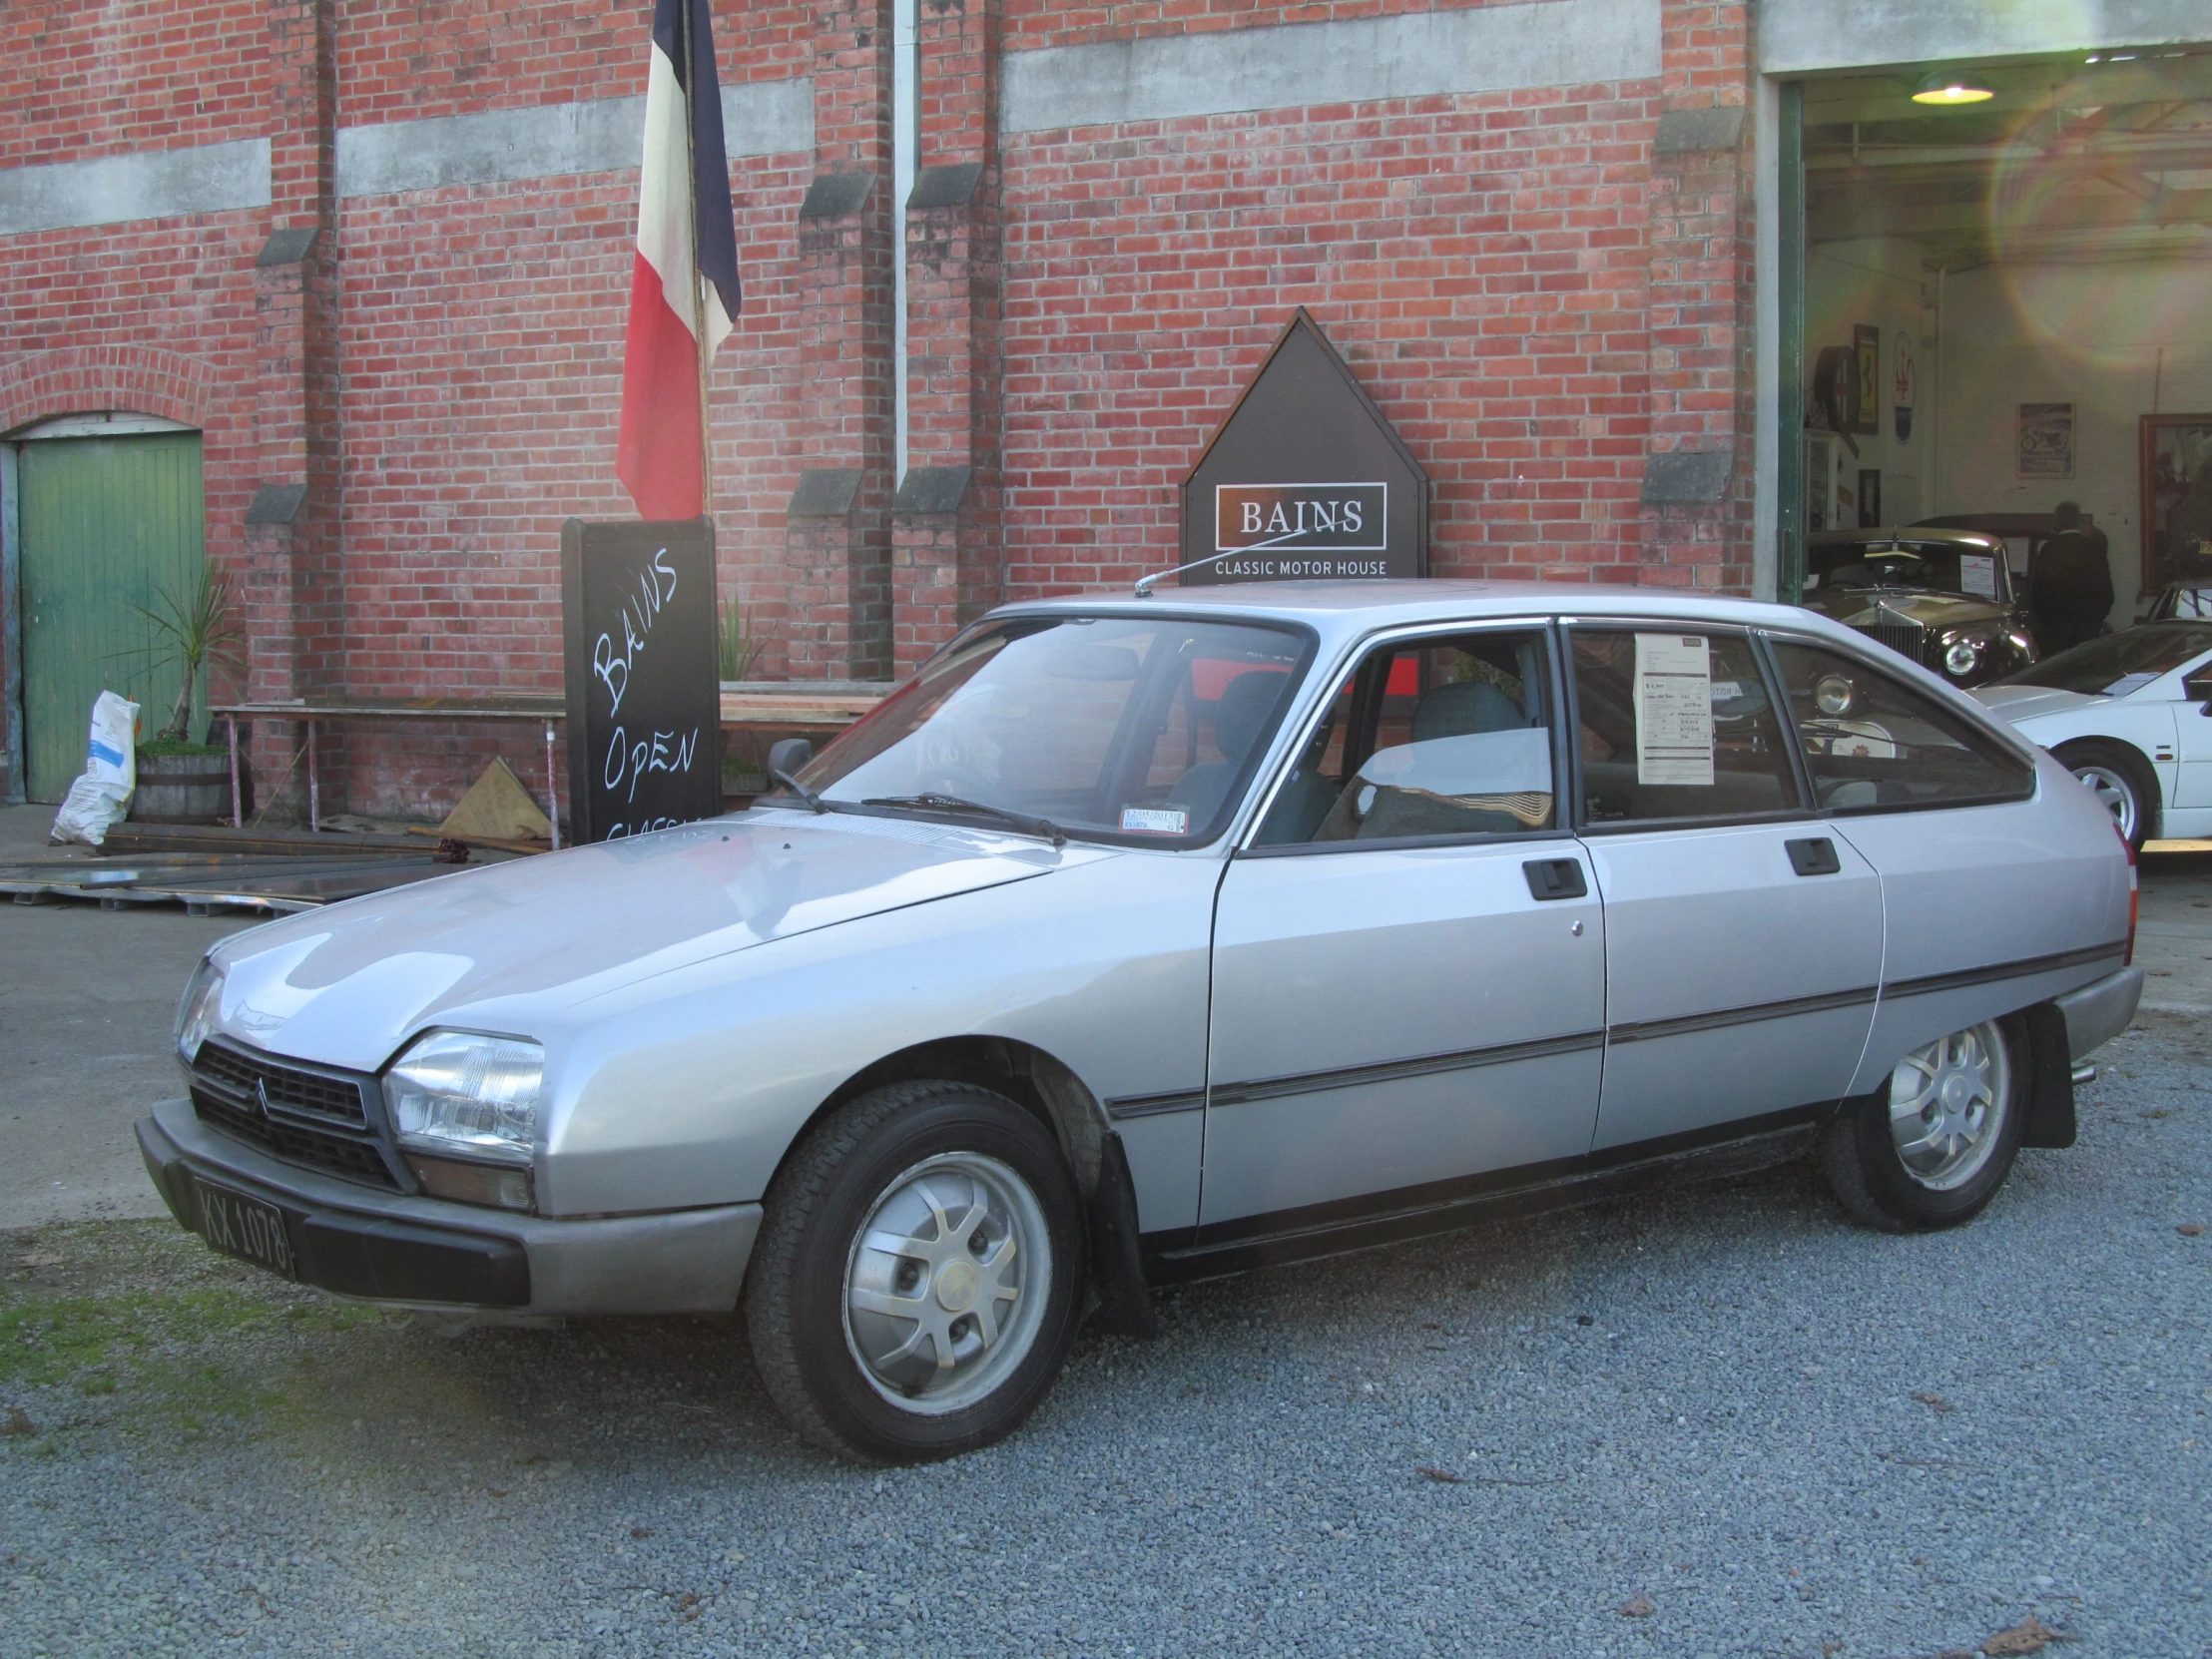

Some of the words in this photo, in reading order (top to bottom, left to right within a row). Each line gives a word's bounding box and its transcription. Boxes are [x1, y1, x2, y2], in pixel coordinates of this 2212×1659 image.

[1241, 500, 1363, 533] BAINS
[1215, 561, 1275, 575] CLASSIC
[1280, 561, 1332, 575] MOTOR
[1338, 561, 1386, 575] HOUSE
[593, 547, 677, 719] BAINS
[604, 726, 699, 804] OPEN
